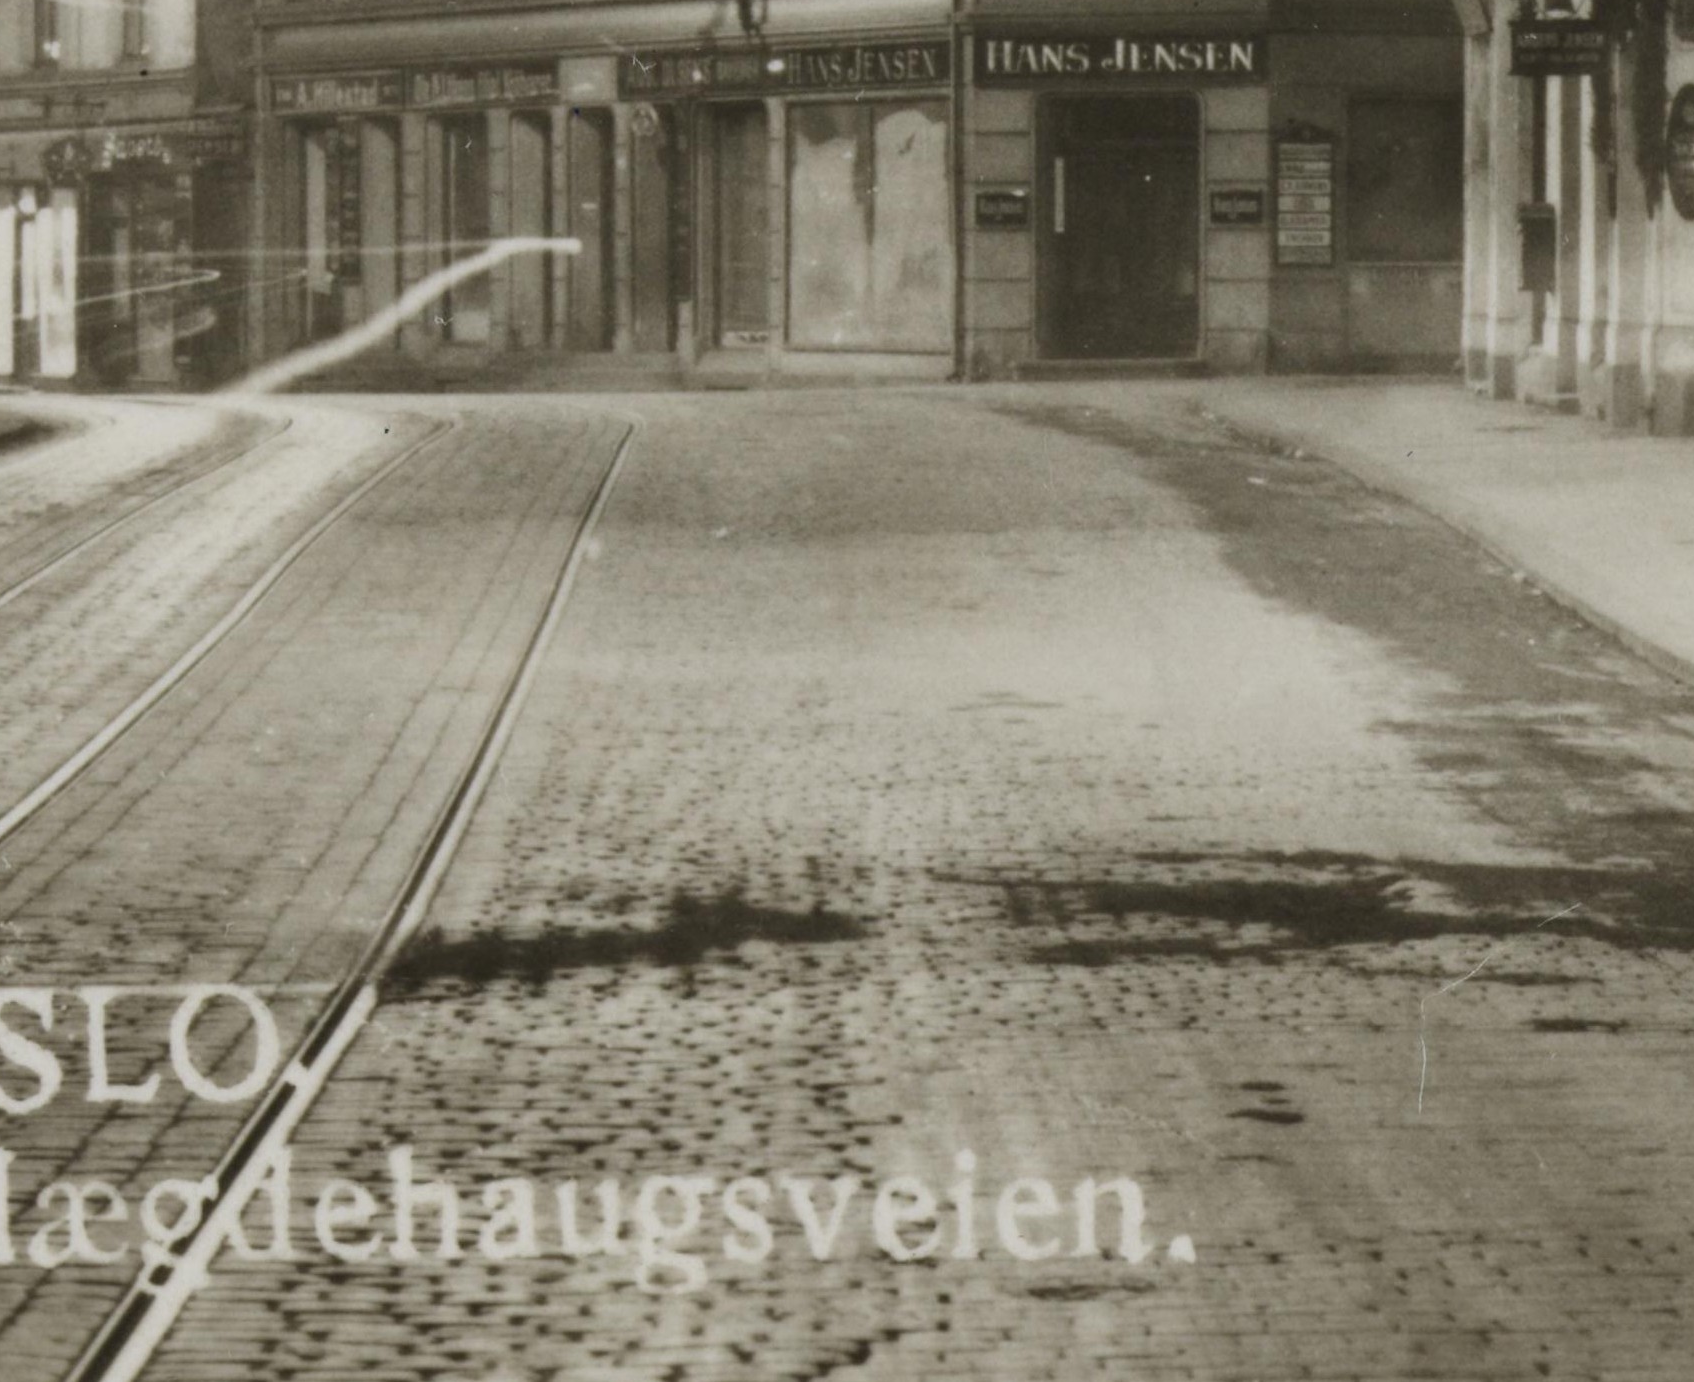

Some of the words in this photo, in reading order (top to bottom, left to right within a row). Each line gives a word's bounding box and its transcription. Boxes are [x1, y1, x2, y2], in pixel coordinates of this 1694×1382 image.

[787, 52, 843, 86] HANS
[847, 47, 939, 81] JENSEN
[986, 40, 1091, 74] HANS
[1101, 39, 1254, 74] JENSEN
